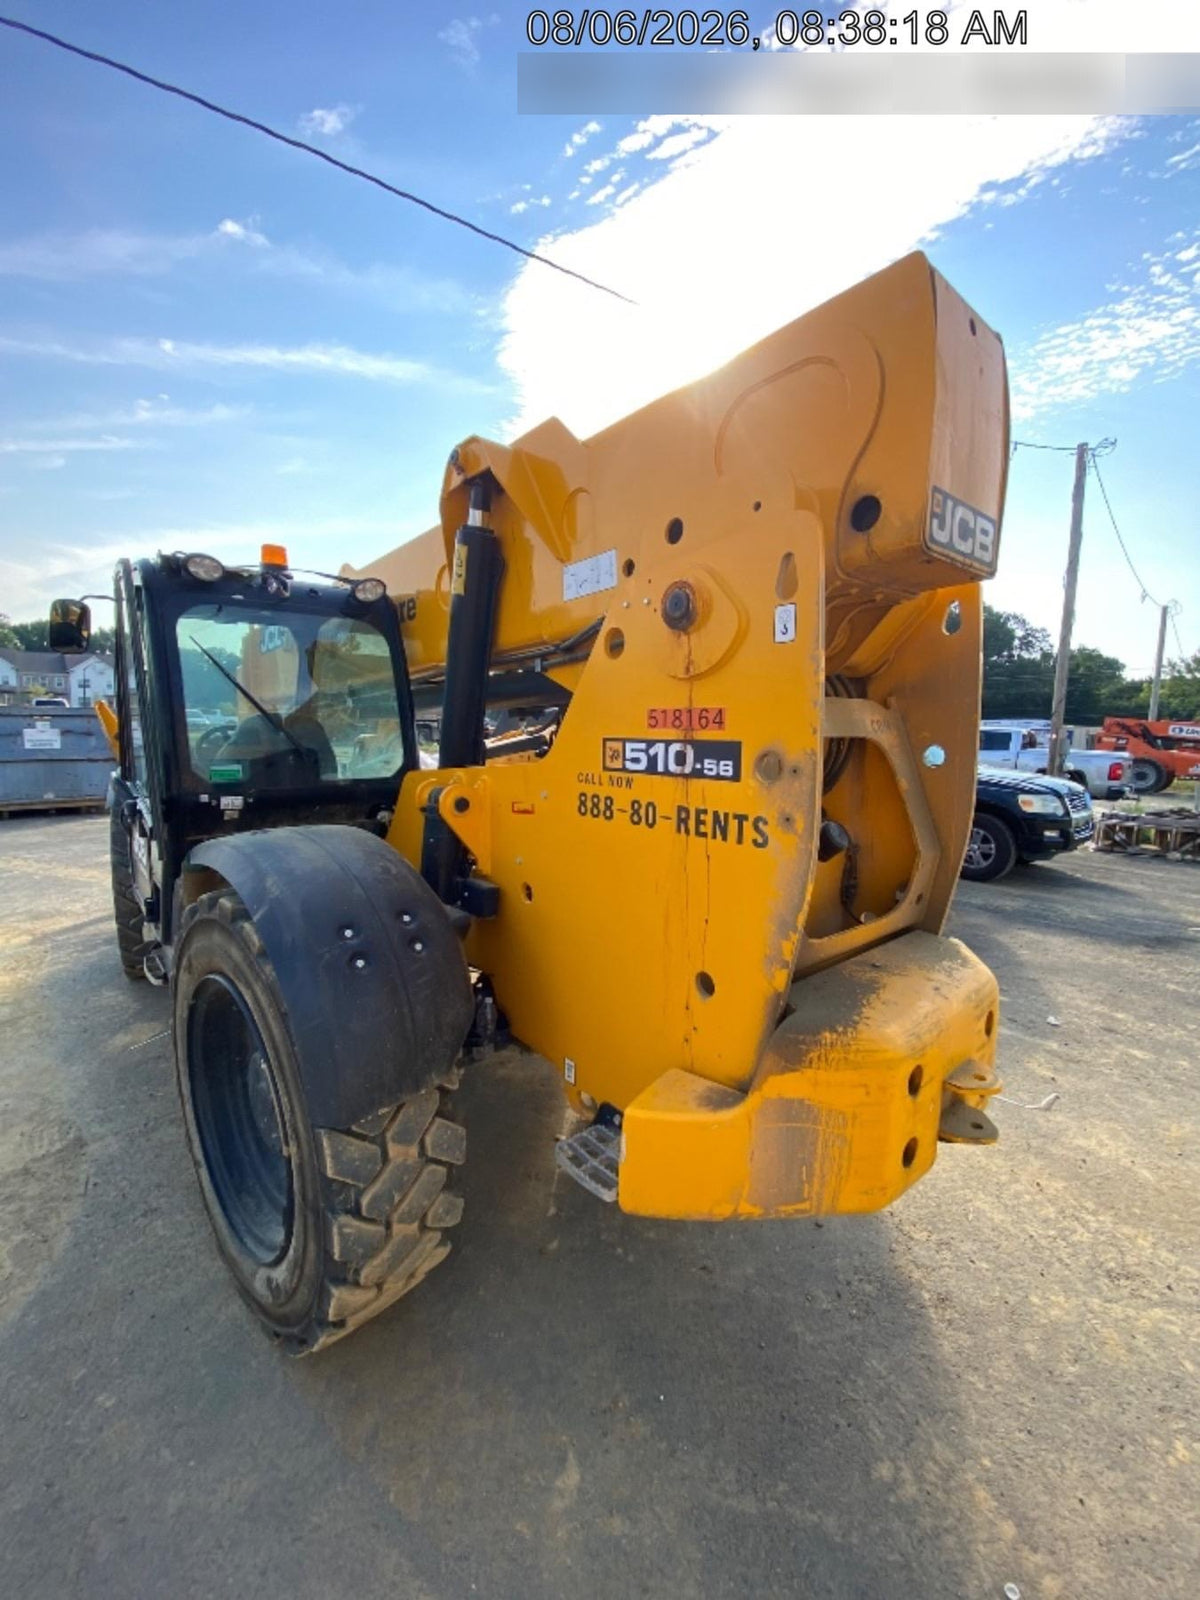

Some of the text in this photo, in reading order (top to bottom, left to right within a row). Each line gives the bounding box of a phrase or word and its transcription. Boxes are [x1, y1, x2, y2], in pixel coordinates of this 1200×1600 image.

[931, 498, 995, 563] JCB
[648, 708, 725, 729] 518164
[577, 772, 634, 790] CALL NOW
[577, 792, 769, 849] 888-80-RENTS
